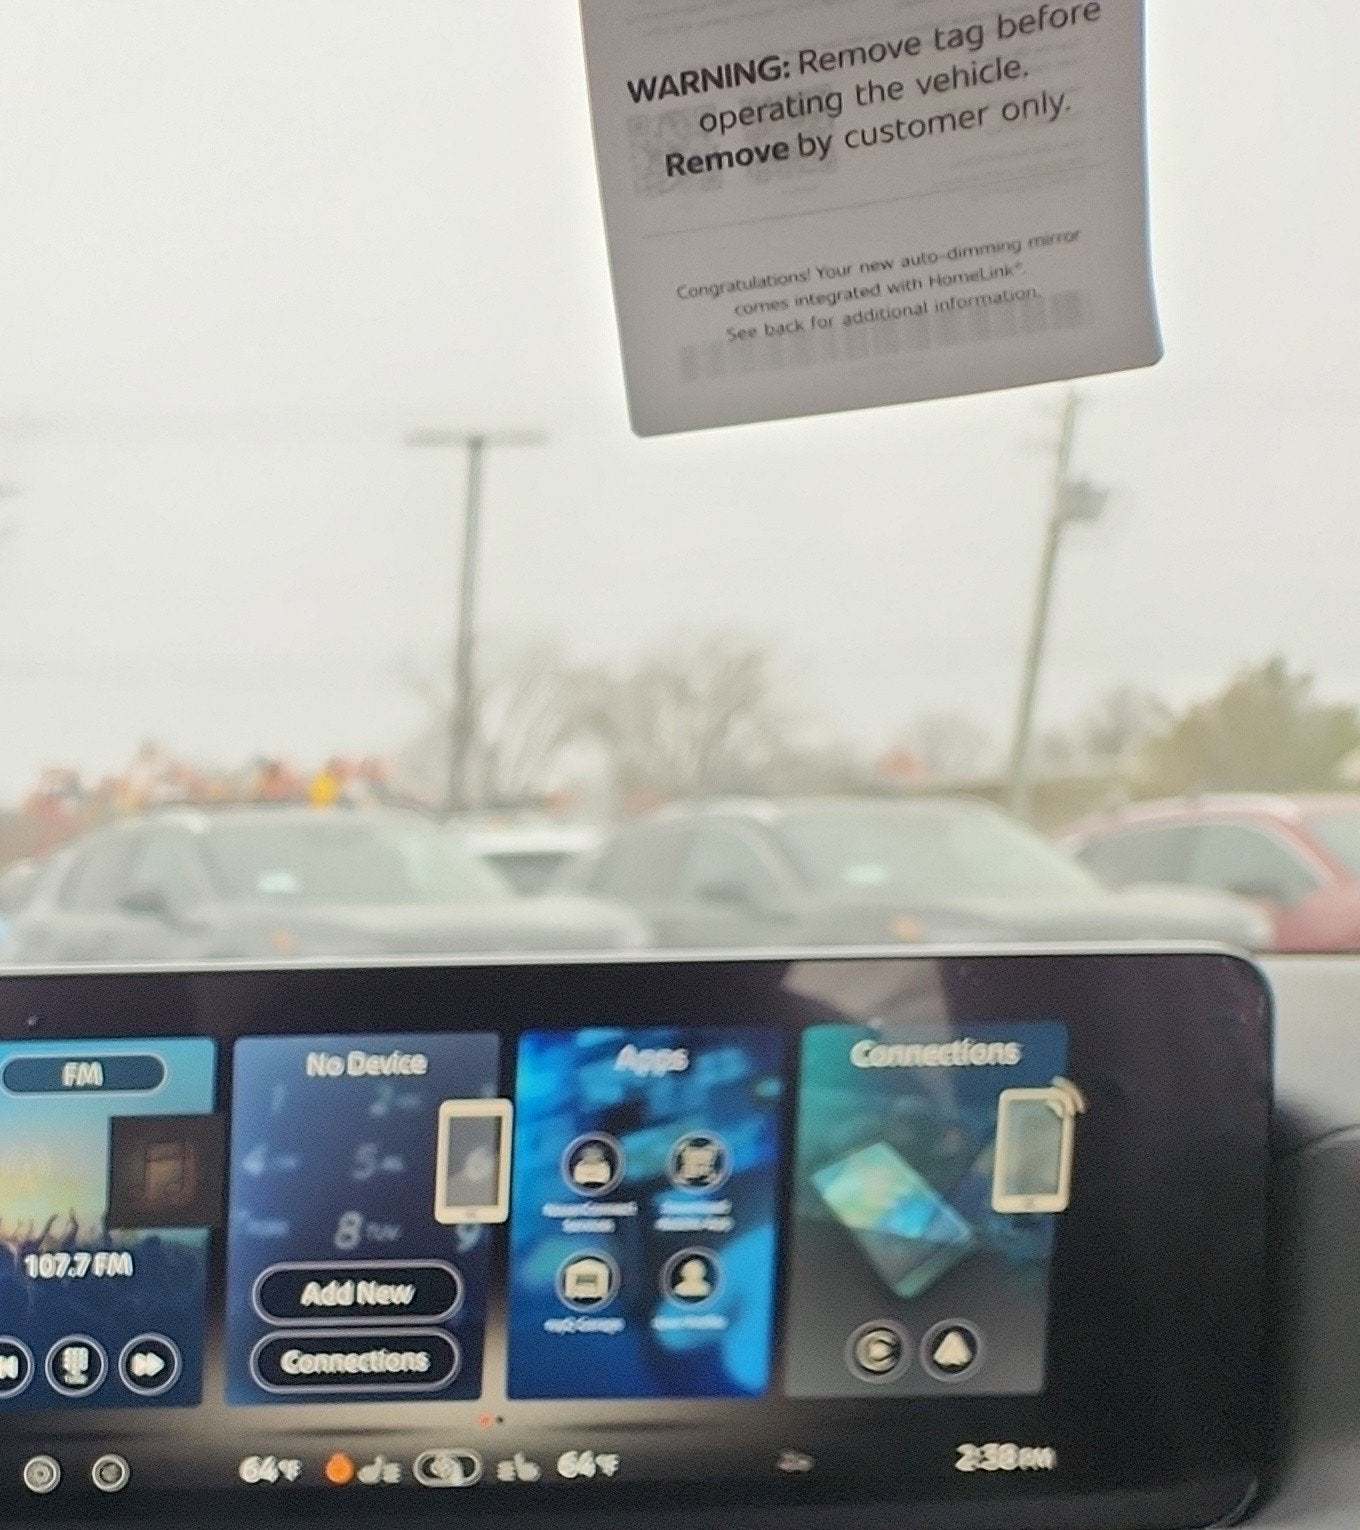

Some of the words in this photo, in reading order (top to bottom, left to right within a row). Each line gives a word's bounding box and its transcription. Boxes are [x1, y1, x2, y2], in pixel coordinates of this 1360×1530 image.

[627, 54, 790, 104] WARNING:
[799, 36, 921, 76] Remove
[934, 24, 984, 51] tag
[998, 1, 1101, 40] before
[699, 91, 843, 135] operating
[856, 79, 904, 107] the
[916, 56, 1029, 96] vehicle.
[665, 140, 790, 178] Remove
[797, 132, 833, 161] by
[844, 103, 990, 149] customer
[1001, 89, 1071, 123] only.
[676, 267, 811, 299] Congratulations!
[815, 263, 853, 280] Your
[859, 257, 894, 273] new
[900, 239, 1022, 269] auto-dimming
[1028, 229, 1080, 249] mirror
[733, 297, 789, 317] comes
[794, 283, 881, 308] integrated
[886, 277, 923, 295] with
[725, 326, 758, 342] See
[763, 319, 805, 338] back
[810, 314, 835, 330] for
[842, 299, 929, 328] additional
[306, 1051, 346, 1078] No
[346, 1050, 429, 1077] Device
[612, 1042, 691, 1078] Apps
[849, 1037, 1023, 1069] Connections
[60, 1060, 104, 1088] FM
[24, 1252, 92, 1279] 107.7
[92, 1250, 134, 1277] FM
[299, 1279, 356, 1307] Add
[355, 1279, 417, 1305] New
[280, 1347, 431, 1375] Connections
